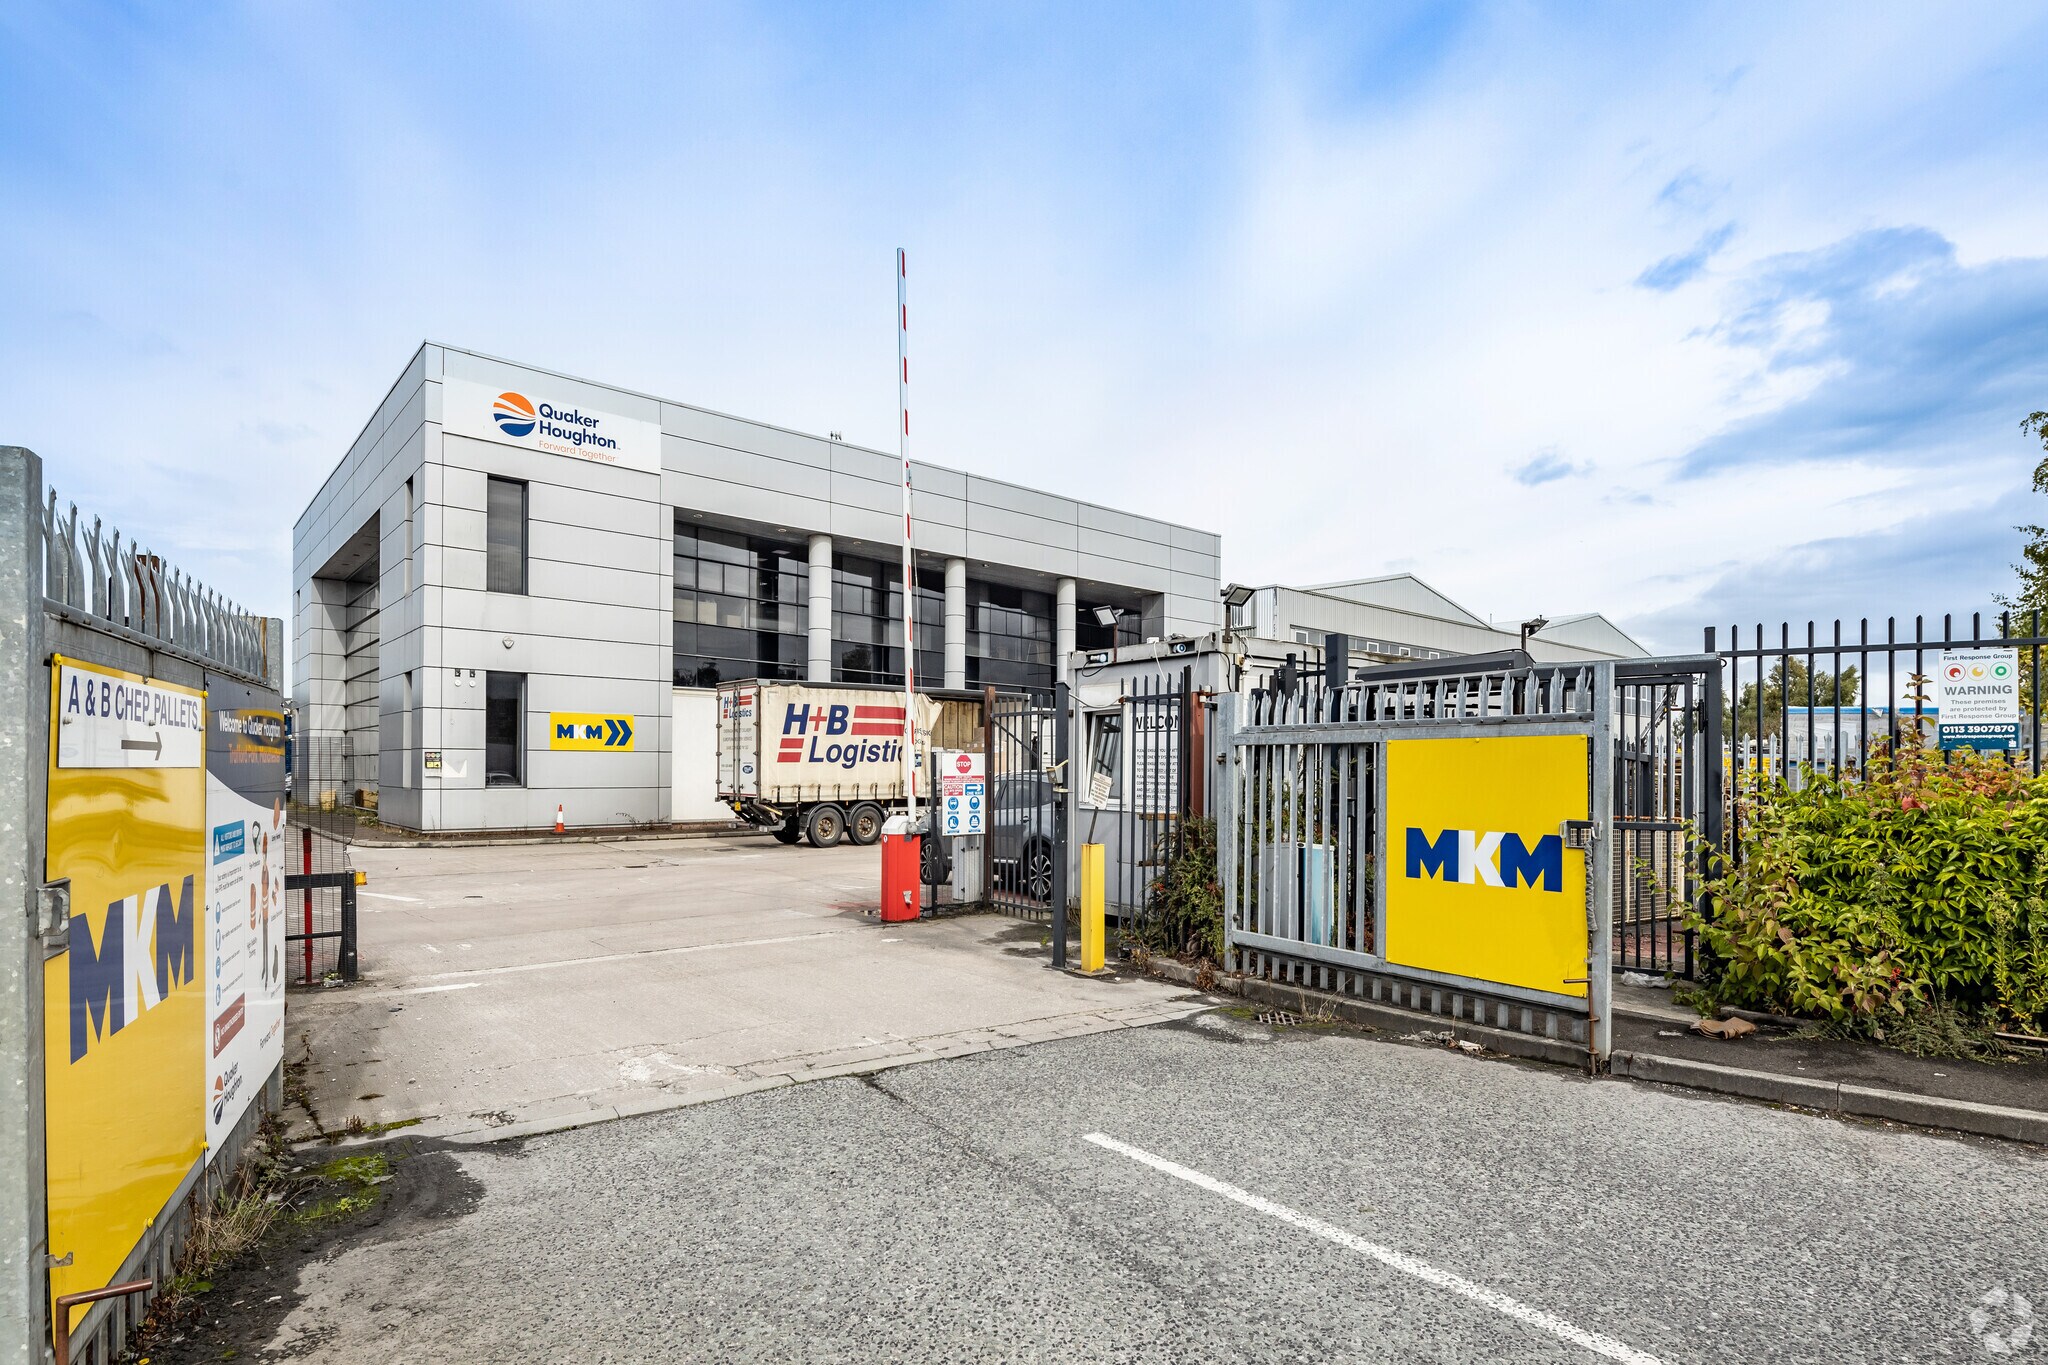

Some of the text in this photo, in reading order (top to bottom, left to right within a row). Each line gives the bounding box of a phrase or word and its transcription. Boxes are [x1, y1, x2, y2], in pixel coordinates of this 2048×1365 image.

[538, 403, 600, 429] Quaker
[538, 420, 617, 450] Houghton
[539, 440, 616, 463] Forward Together
[68, 675, 199, 730] A & B CHEP PALLETS
[1944, 685, 2012, 695] WARNING
[218, 709, 242, 734] Welcome
[242, 715, 248, 734] to
[247, 714, 263, 736] Quaker
[556, 724, 603, 740] MKM
[1942, 725, 2016, 733] 0113 3907870
[1405, 827, 1563, 893] MKM
[69, 874, 194, 1065] MKM
[224, 1061, 239, 1086] Quaker
[224, 1074, 243, 1106] Houghton
